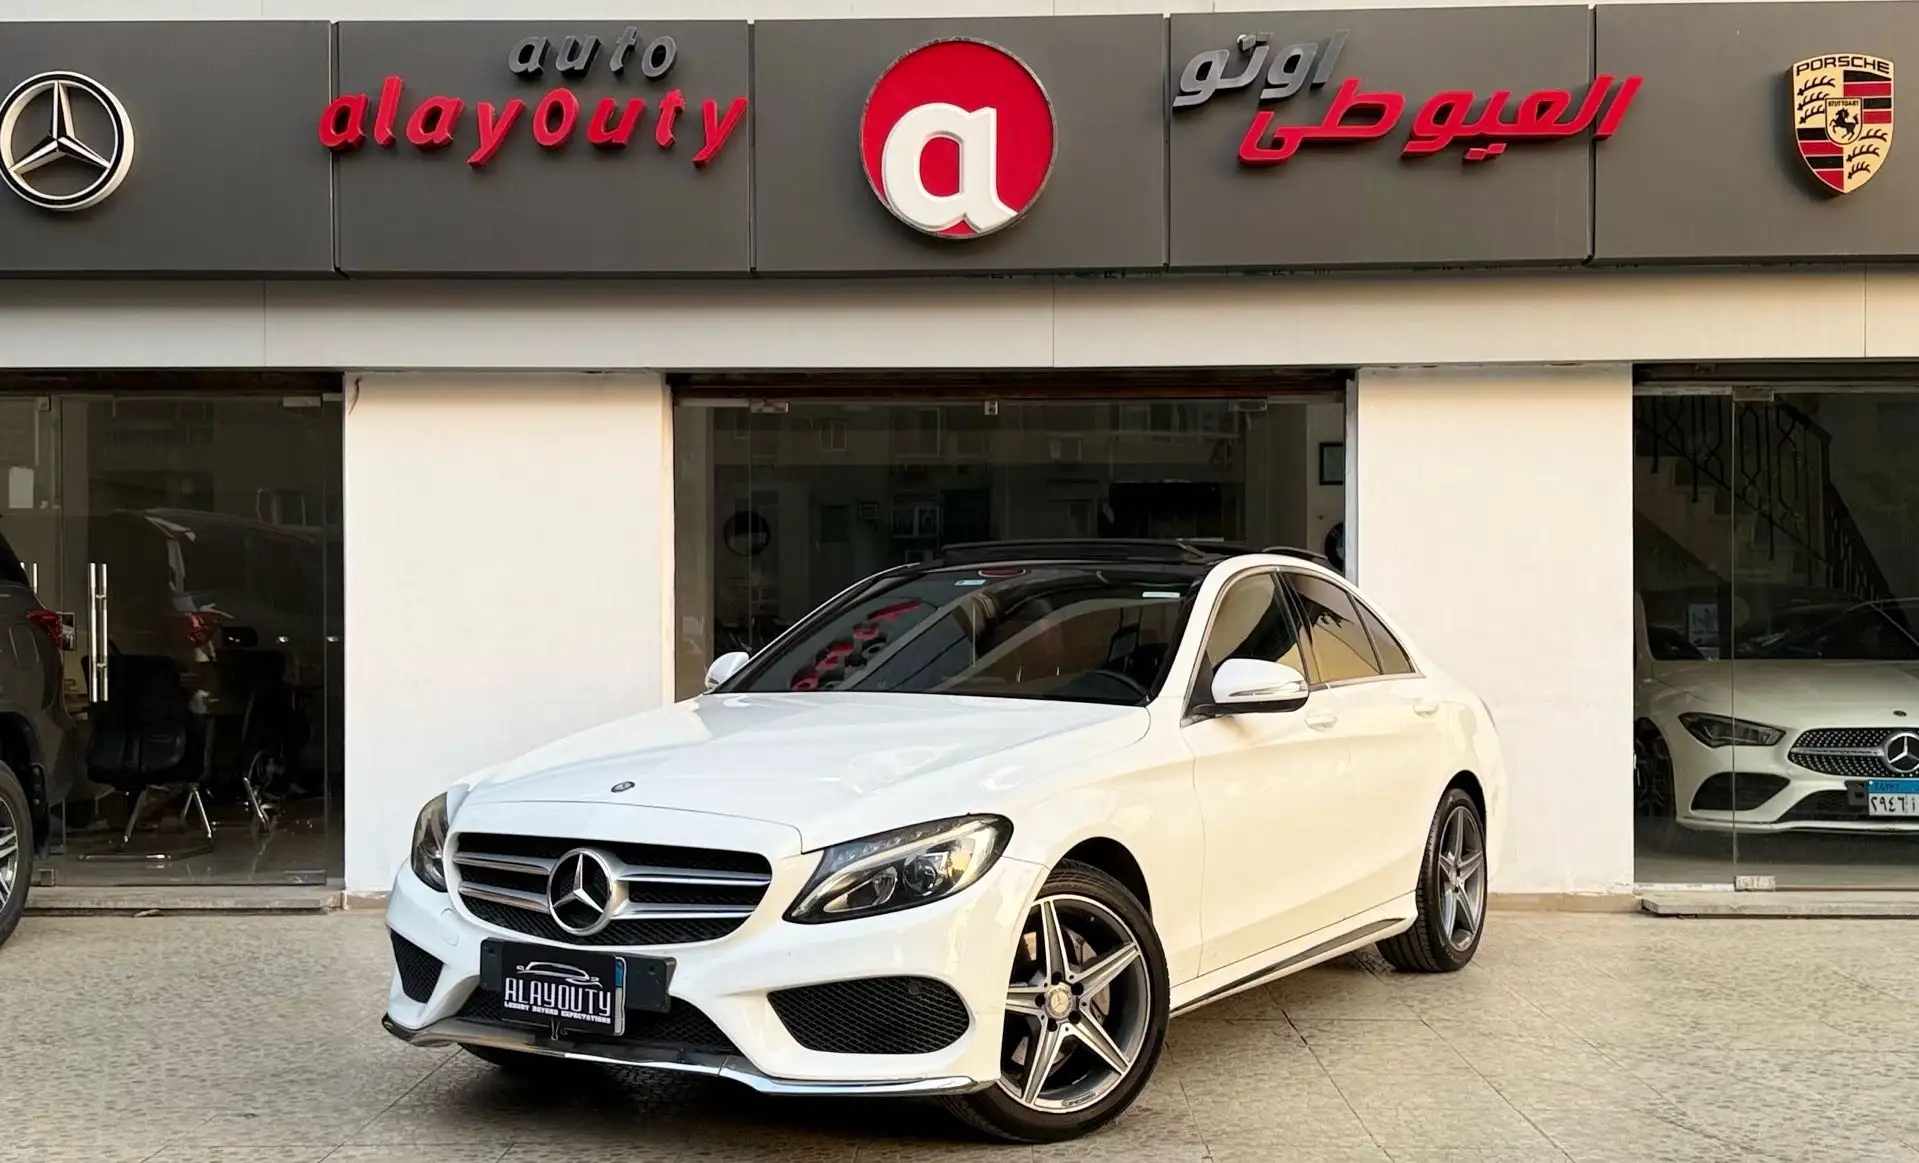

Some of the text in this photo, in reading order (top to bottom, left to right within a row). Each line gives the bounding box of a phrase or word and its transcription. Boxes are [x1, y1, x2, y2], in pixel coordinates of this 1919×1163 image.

[508, 27, 677, 80] auto
[1173, 29, 1349, 108] اوتو
[1796, 56, 1890, 77] PORSCHE
[881, 102, 1018, 233] a
[504, 977, 612, 1017] ALAYOUTY
[561, 1010, 612, 1024] EXPECTATIONS
